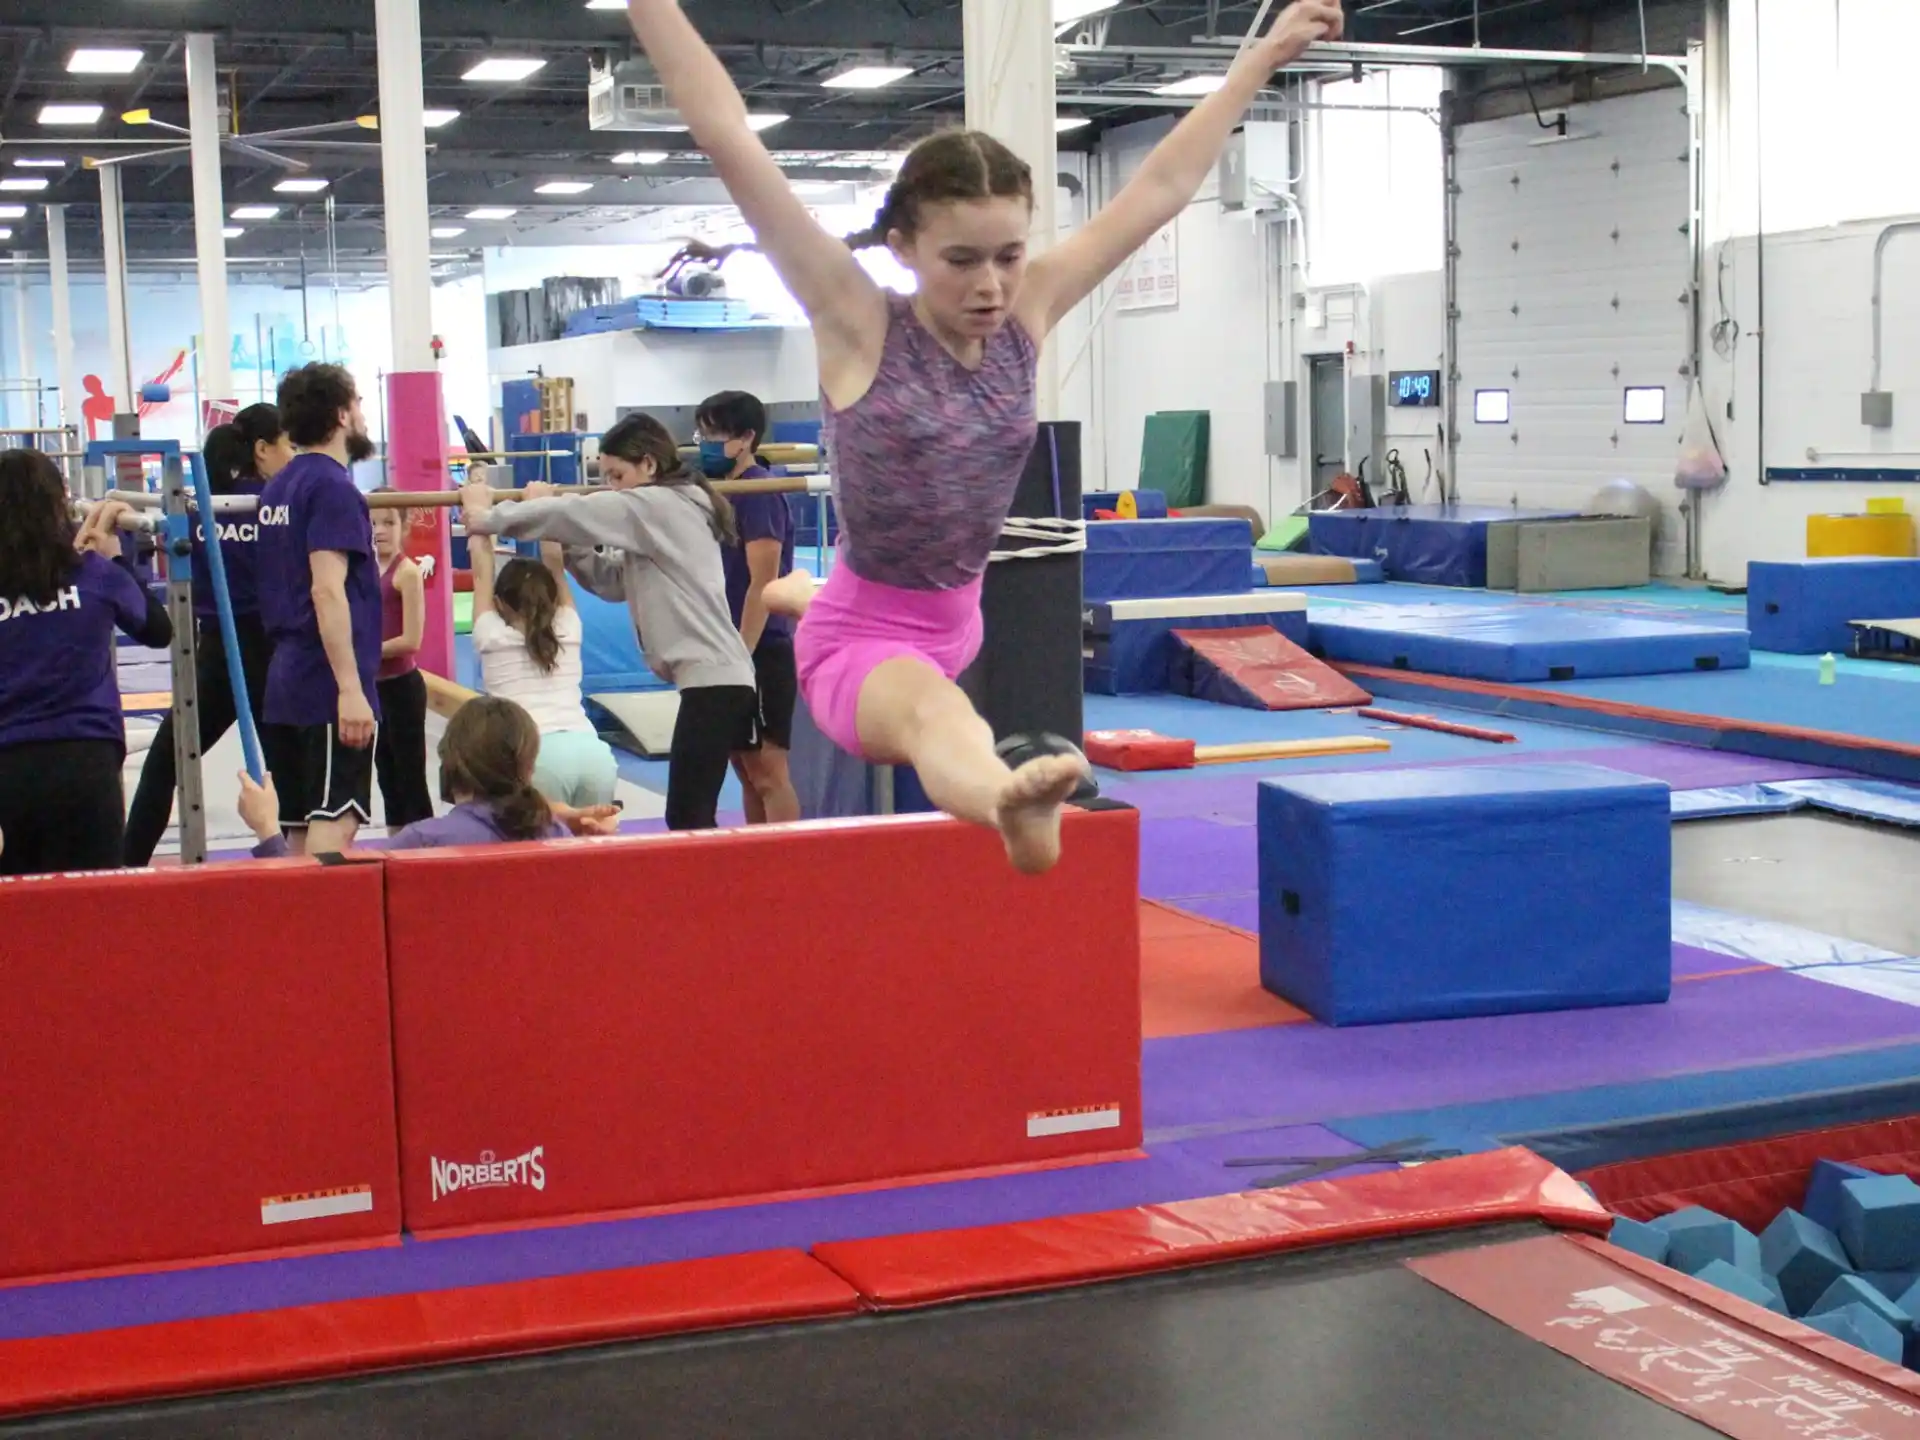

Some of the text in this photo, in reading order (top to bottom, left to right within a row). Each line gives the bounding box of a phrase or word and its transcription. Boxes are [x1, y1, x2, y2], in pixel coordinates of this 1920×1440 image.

[1398, 375, 1430, 398] 10:49
[430, 1145, 545, 1203] NORBERTS
[282, 1186, 361, 1203] WARNING
